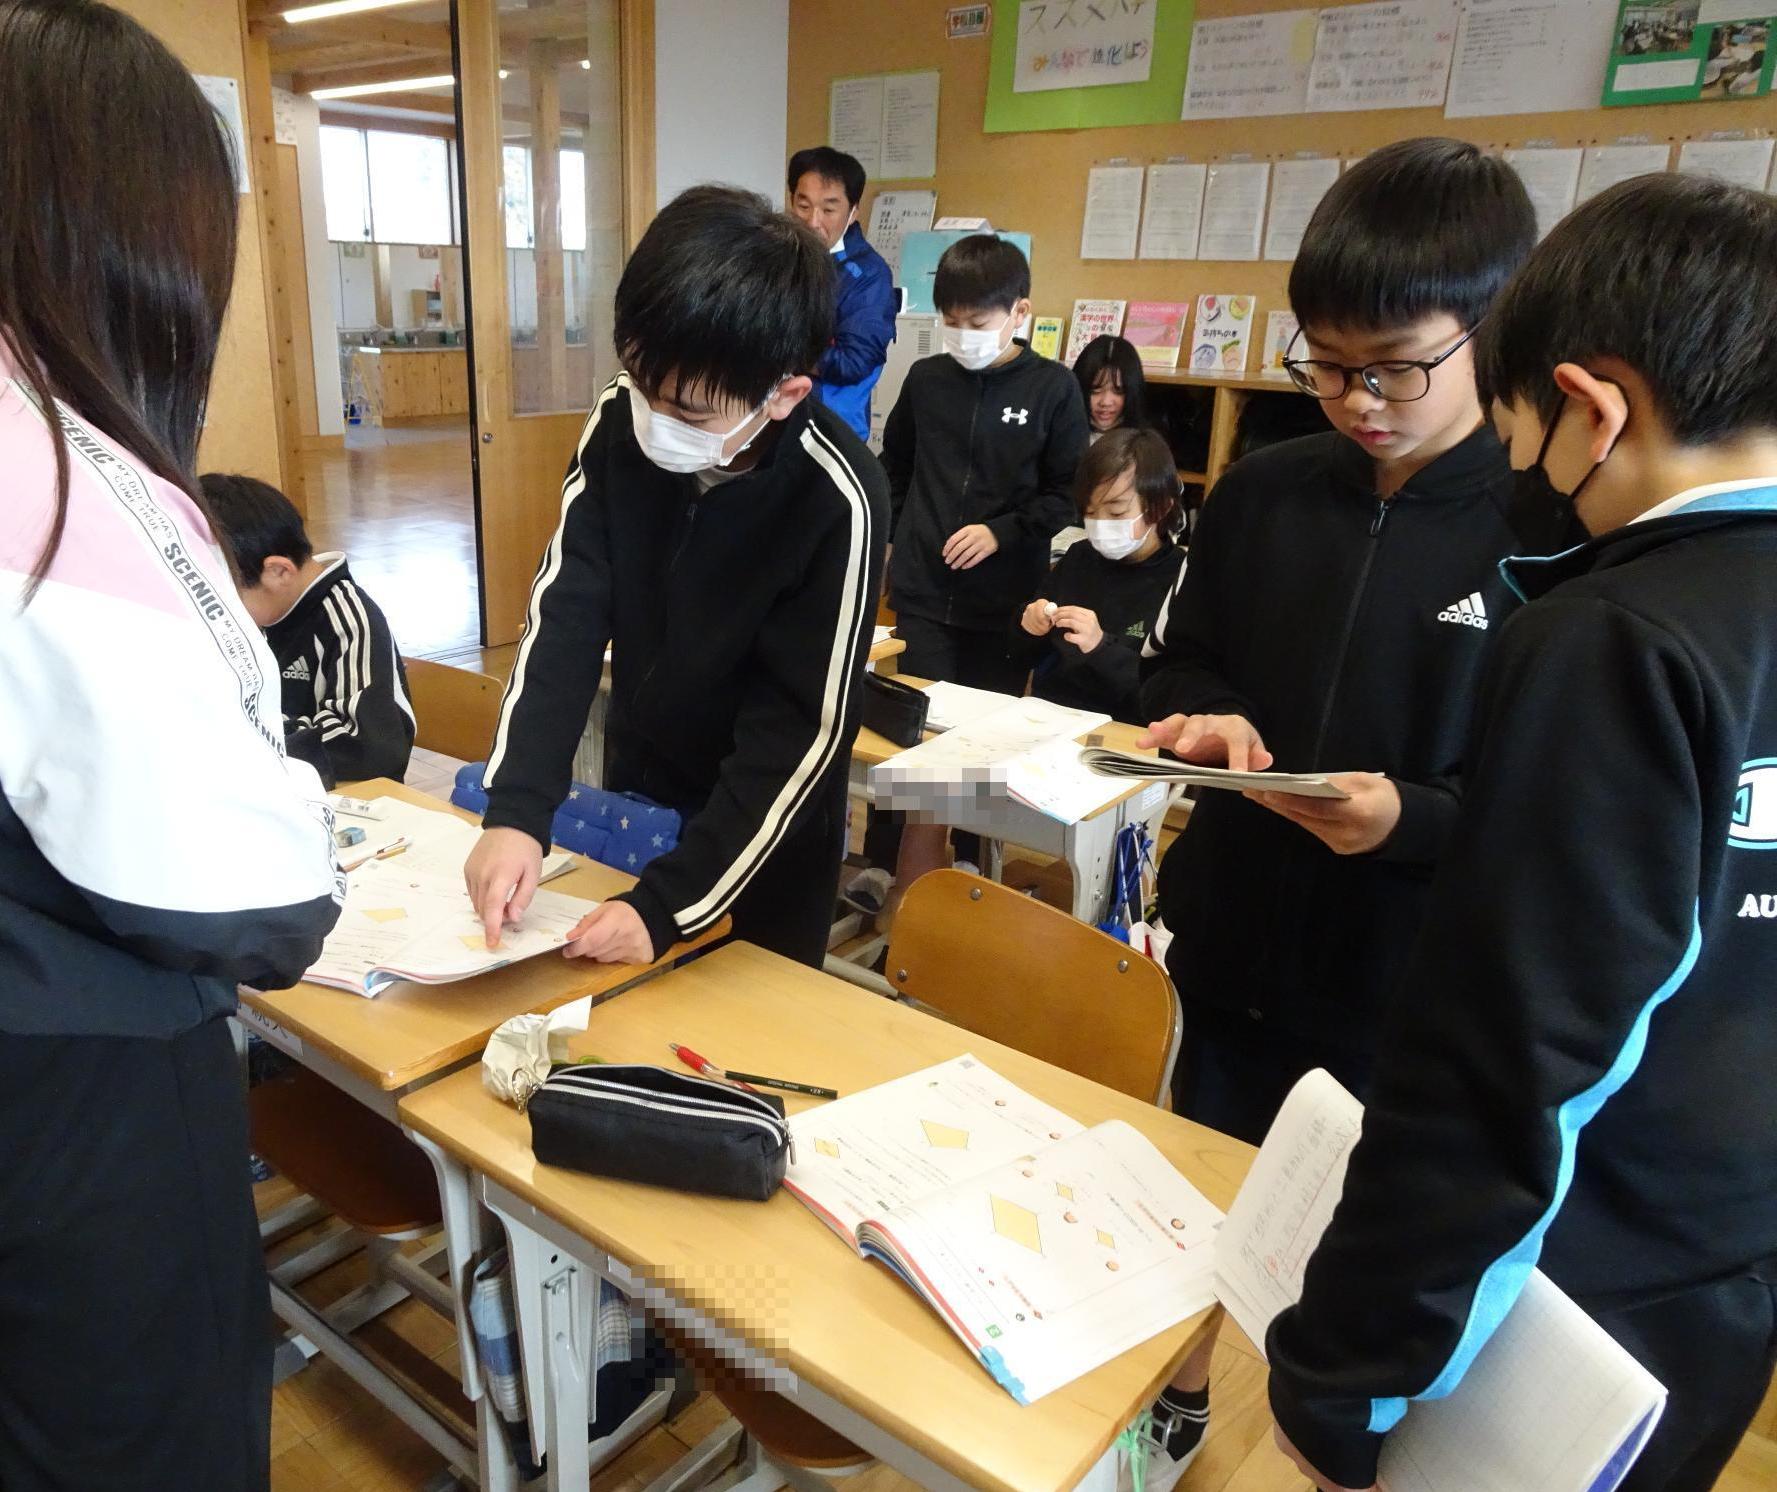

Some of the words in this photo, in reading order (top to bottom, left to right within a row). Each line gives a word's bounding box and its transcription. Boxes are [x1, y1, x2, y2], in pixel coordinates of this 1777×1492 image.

[56, 408, 116, 464] CENIC
[164, 542, 225, 621] SCENIC
[1437, 611, 1489, 630] adidas
